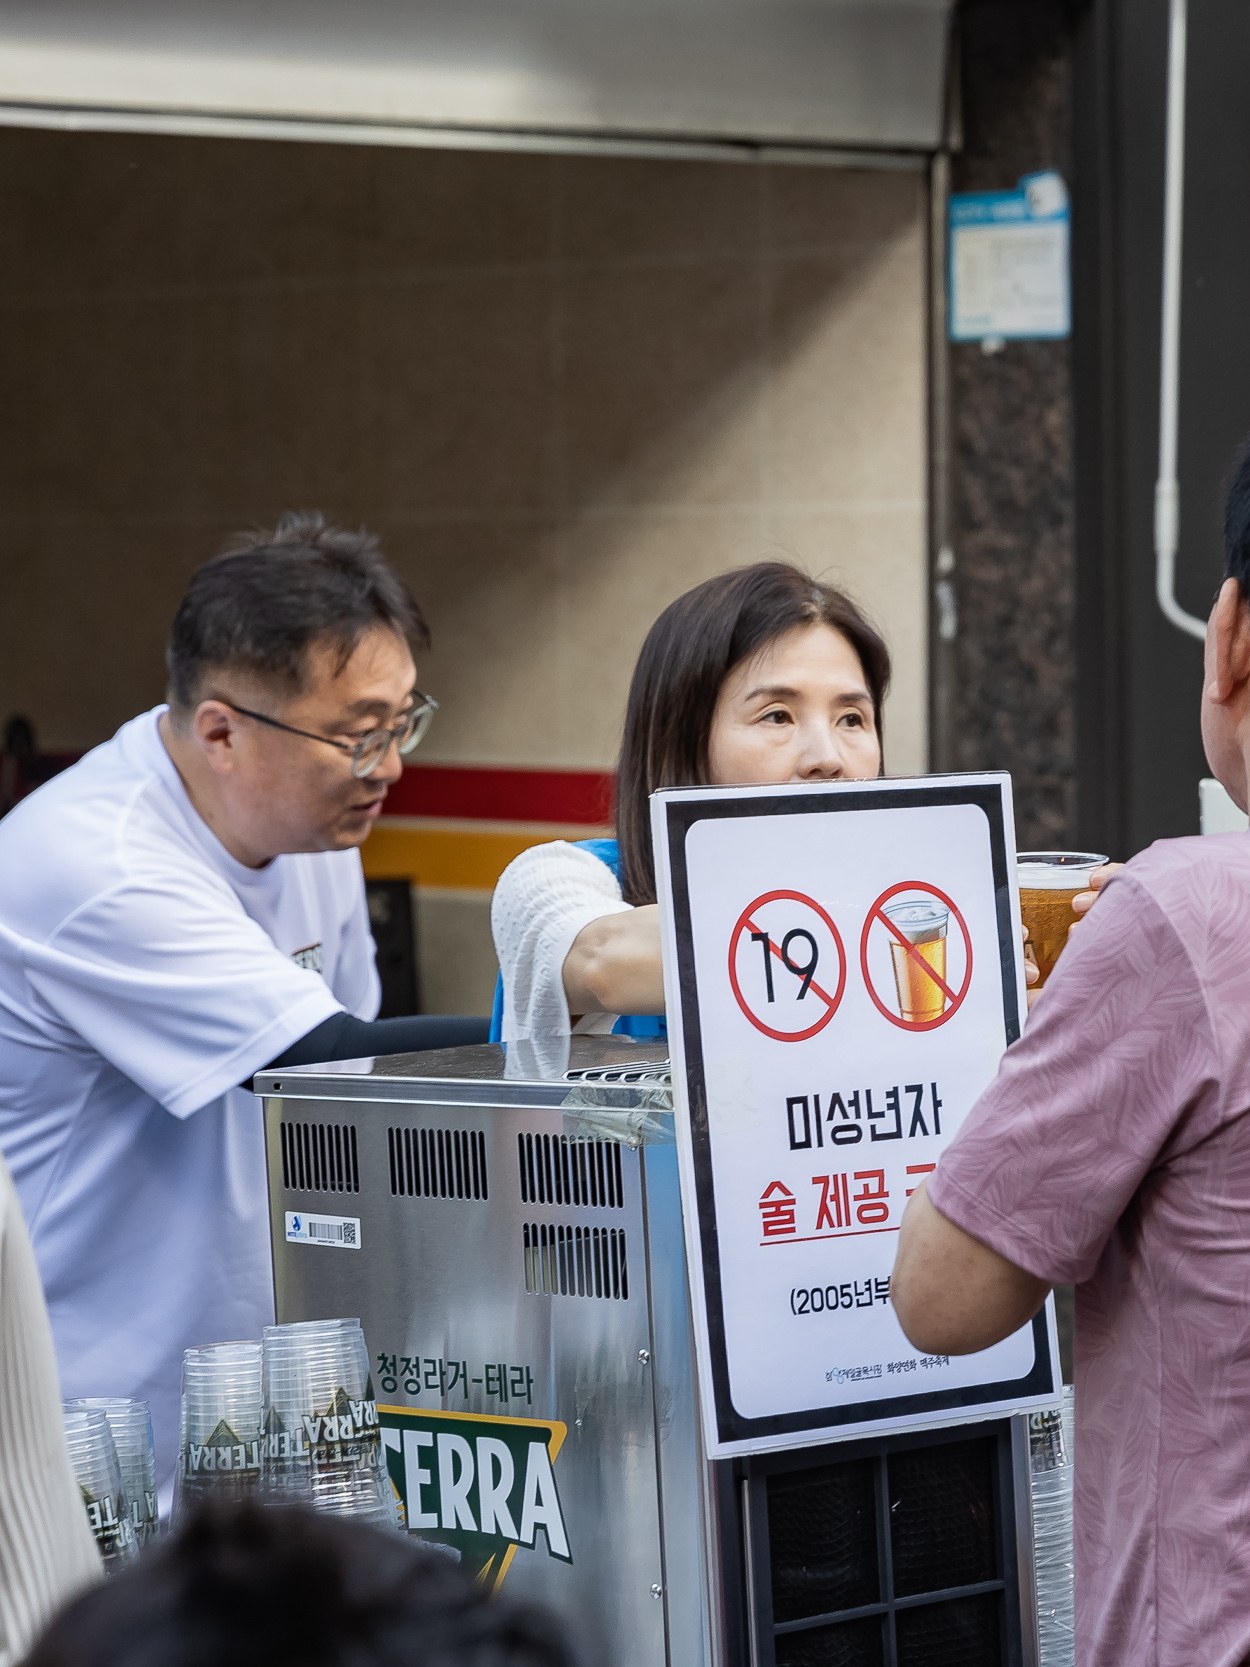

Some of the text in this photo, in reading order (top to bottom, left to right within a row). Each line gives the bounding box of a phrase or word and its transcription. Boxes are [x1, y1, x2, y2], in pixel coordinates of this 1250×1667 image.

[751, 928, 818, 1003] 19
[786, 1082, 943, 1151] 미성년자
[758, 1180, 796, 1237] 술
[811, 1167, 889, 1230] 제공
[377, 1353, 533, 1405] 청정라거-테라
[189, 1439, 261, 1472] TERRA
